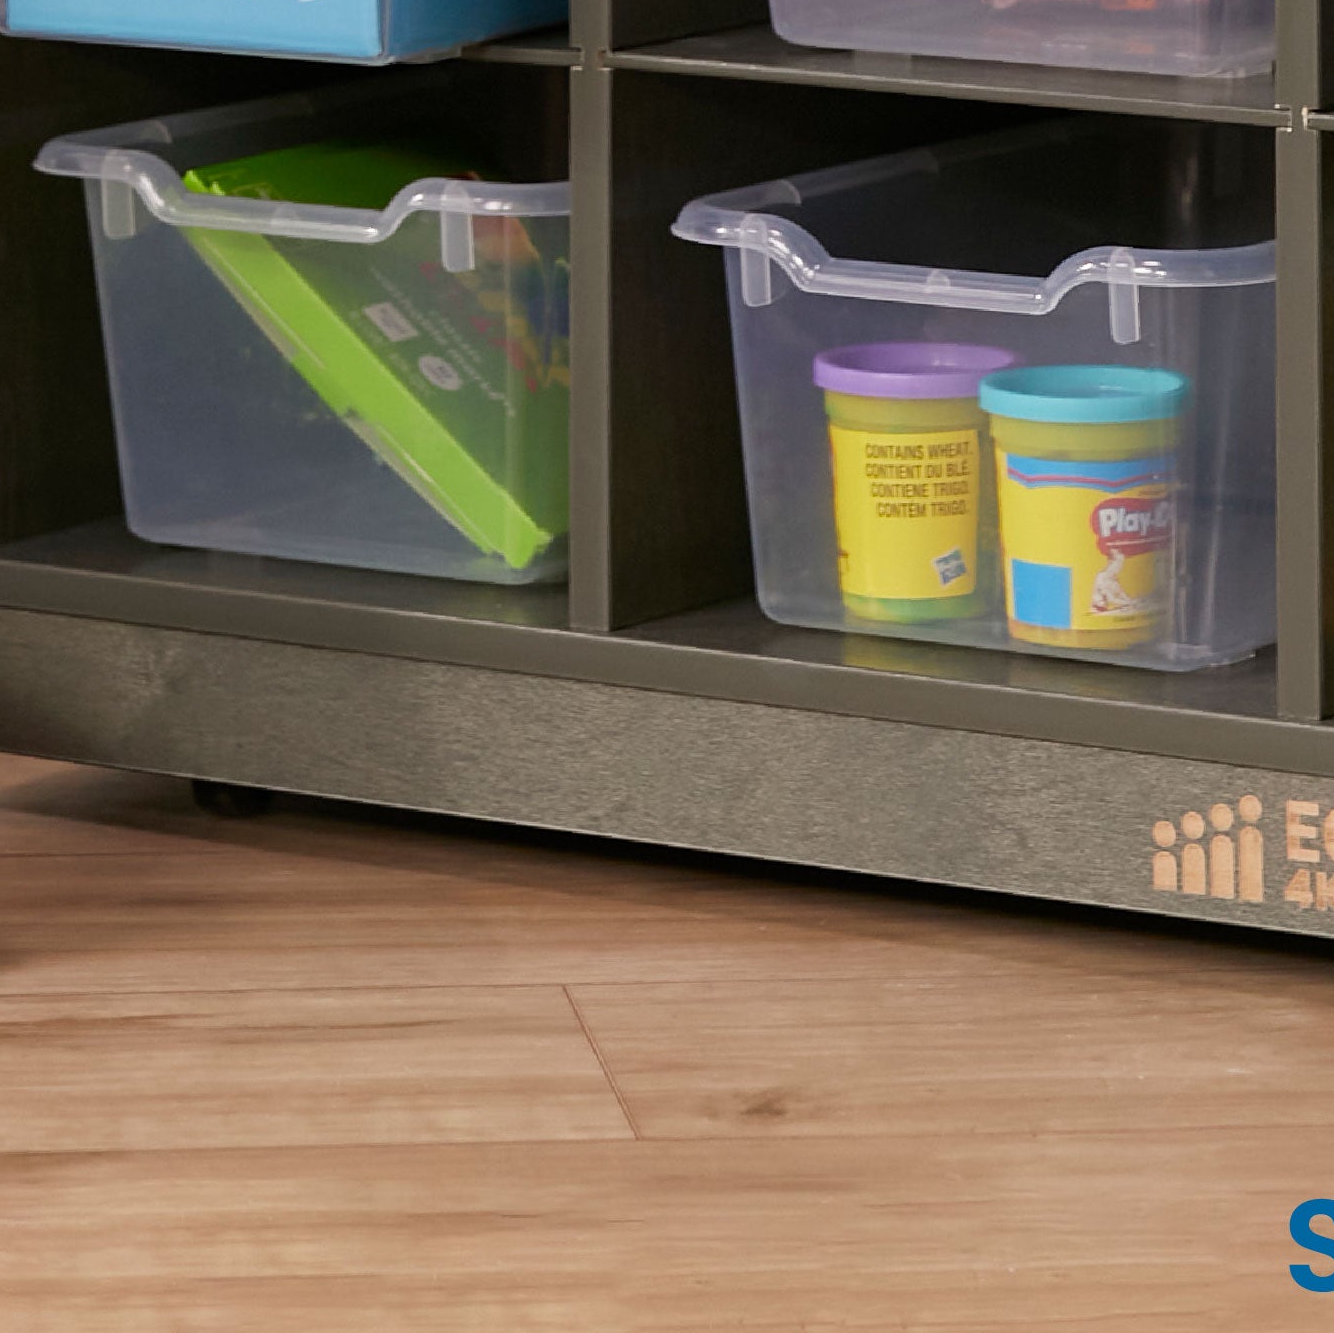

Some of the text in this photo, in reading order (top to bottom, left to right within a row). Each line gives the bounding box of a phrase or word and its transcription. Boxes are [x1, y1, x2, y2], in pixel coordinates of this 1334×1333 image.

[865, 443, 925, 460] CONTAINS
[865, 463, 922, 479] CONTIENT
[924, 464, 943, 479] DU
[870, 482, 929, 498] CONTIENE
